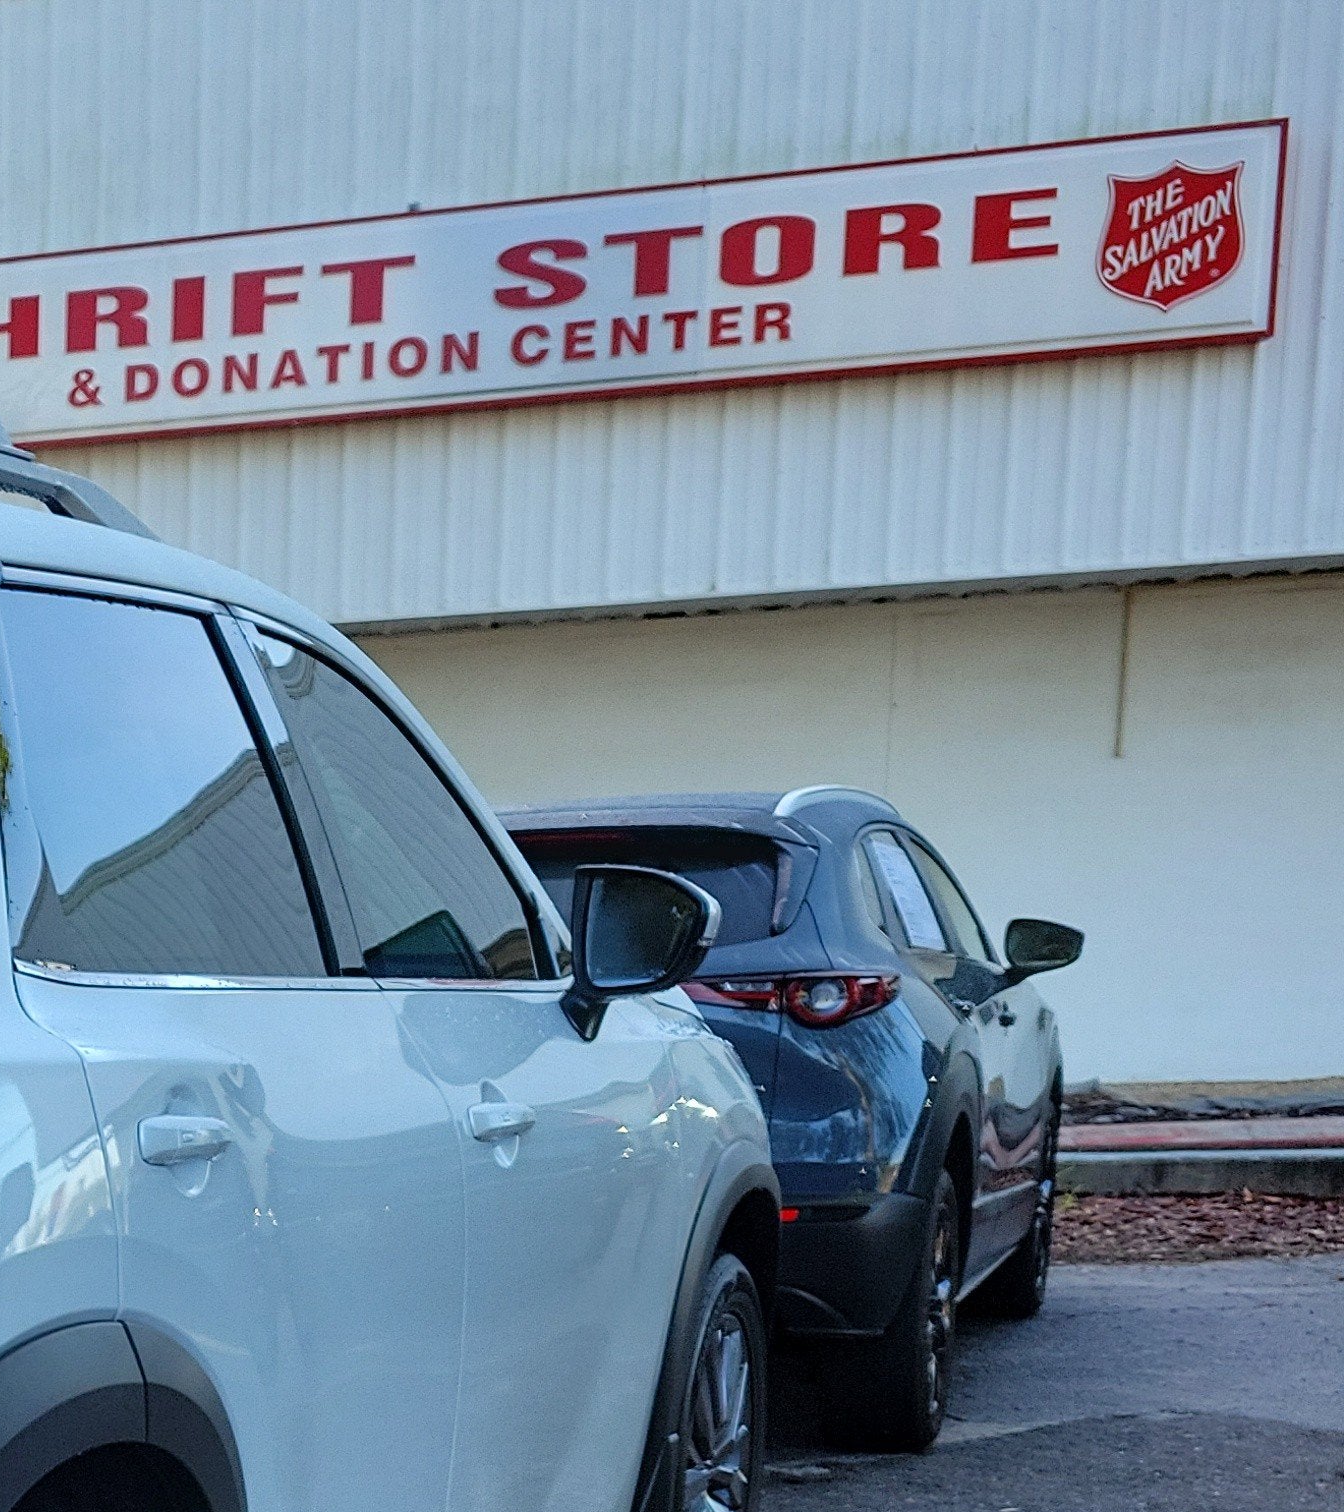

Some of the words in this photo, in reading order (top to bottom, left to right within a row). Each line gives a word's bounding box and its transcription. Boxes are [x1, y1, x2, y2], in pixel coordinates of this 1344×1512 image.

[493, 187, 1059, 309] STORE
[1102, 180, 1233, 282] SALVATION
[1126, 177, 1186, 232] THE
[1143, 225, 1226, 298] ARMY
[68, 368, 103, 408] &
[124, 331, 481, 403] DONATION
[512, 302, 792, 366] CENTER
